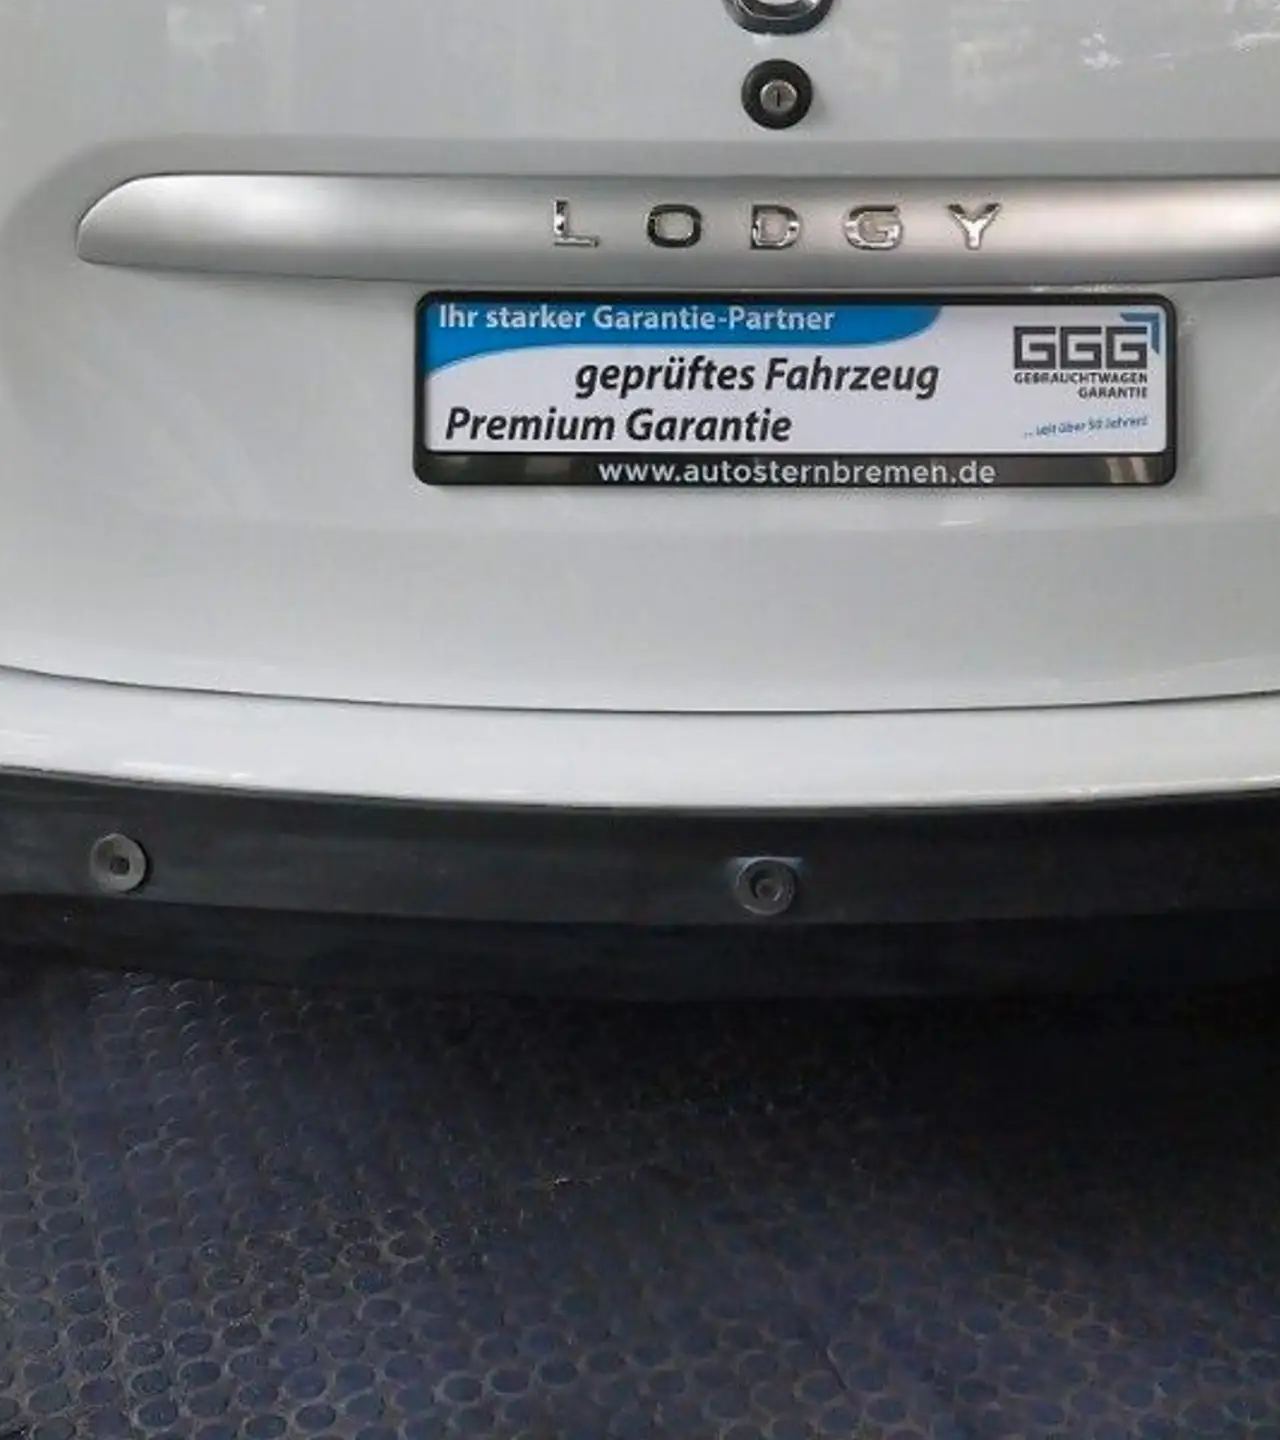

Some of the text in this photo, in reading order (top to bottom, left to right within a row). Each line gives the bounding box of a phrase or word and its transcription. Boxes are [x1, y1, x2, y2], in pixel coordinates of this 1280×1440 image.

[552, 199, 1003, 251] LODGY
[439, 304, 836, 331] Ihr starker Garantie-Partner
[1014, 326, 1147, 369] GGG
[575, 355, 939, 400] geprüftes Fahrzeug
[1013, 372, 1148, 385] GEBRAUCHTWAGEN
[1078, 386, 1148, 399] GARANTIE
[445, 406, 793, 442] Premium Garantie
[598, 459, 997, 483] www.autosternbremen.de
